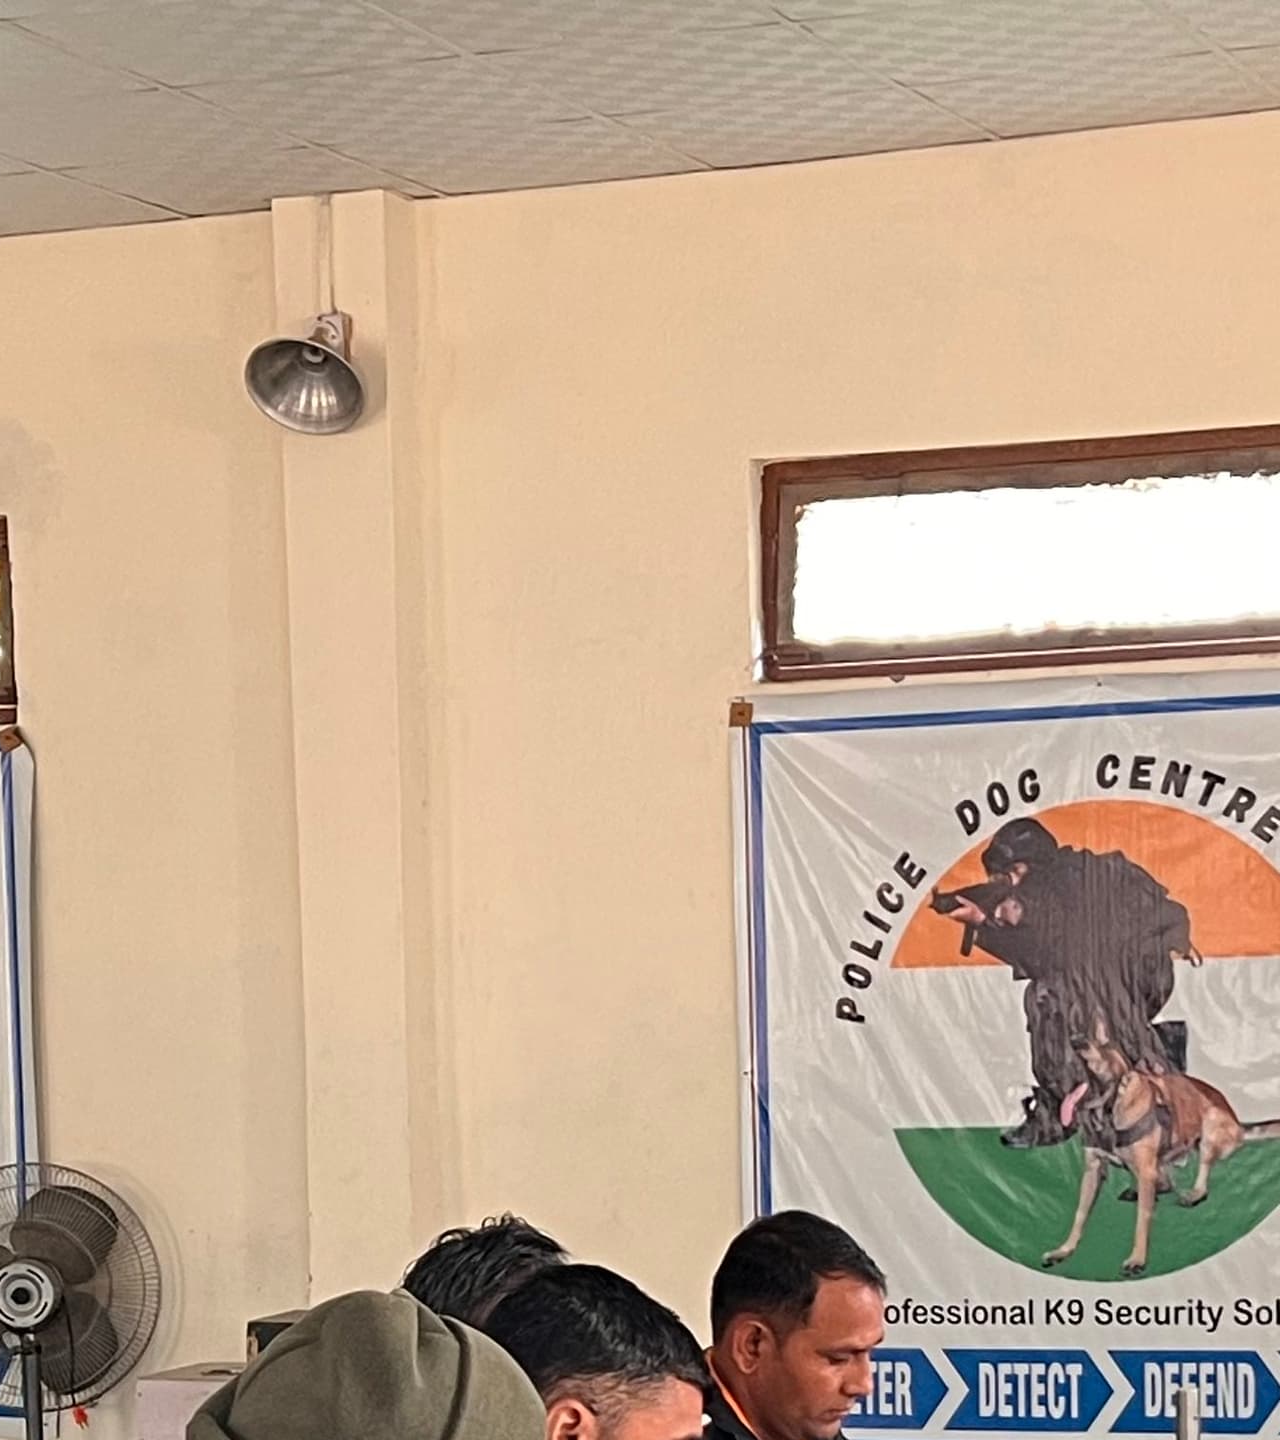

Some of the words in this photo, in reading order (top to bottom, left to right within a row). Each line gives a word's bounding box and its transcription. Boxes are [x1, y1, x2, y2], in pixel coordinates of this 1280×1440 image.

[836, 853, 927, 1024] POLICE
[955, 769, 1041, 836] DOG
[883, 1298, 1034, 1325] ofessional
[1045, 1299, 1084, 1326] K9
[1094, 1299, 1224, 1333] Security
[849, 1361, 913, 1416] TER
[978, 1361, 1083, 1420] DETECT
